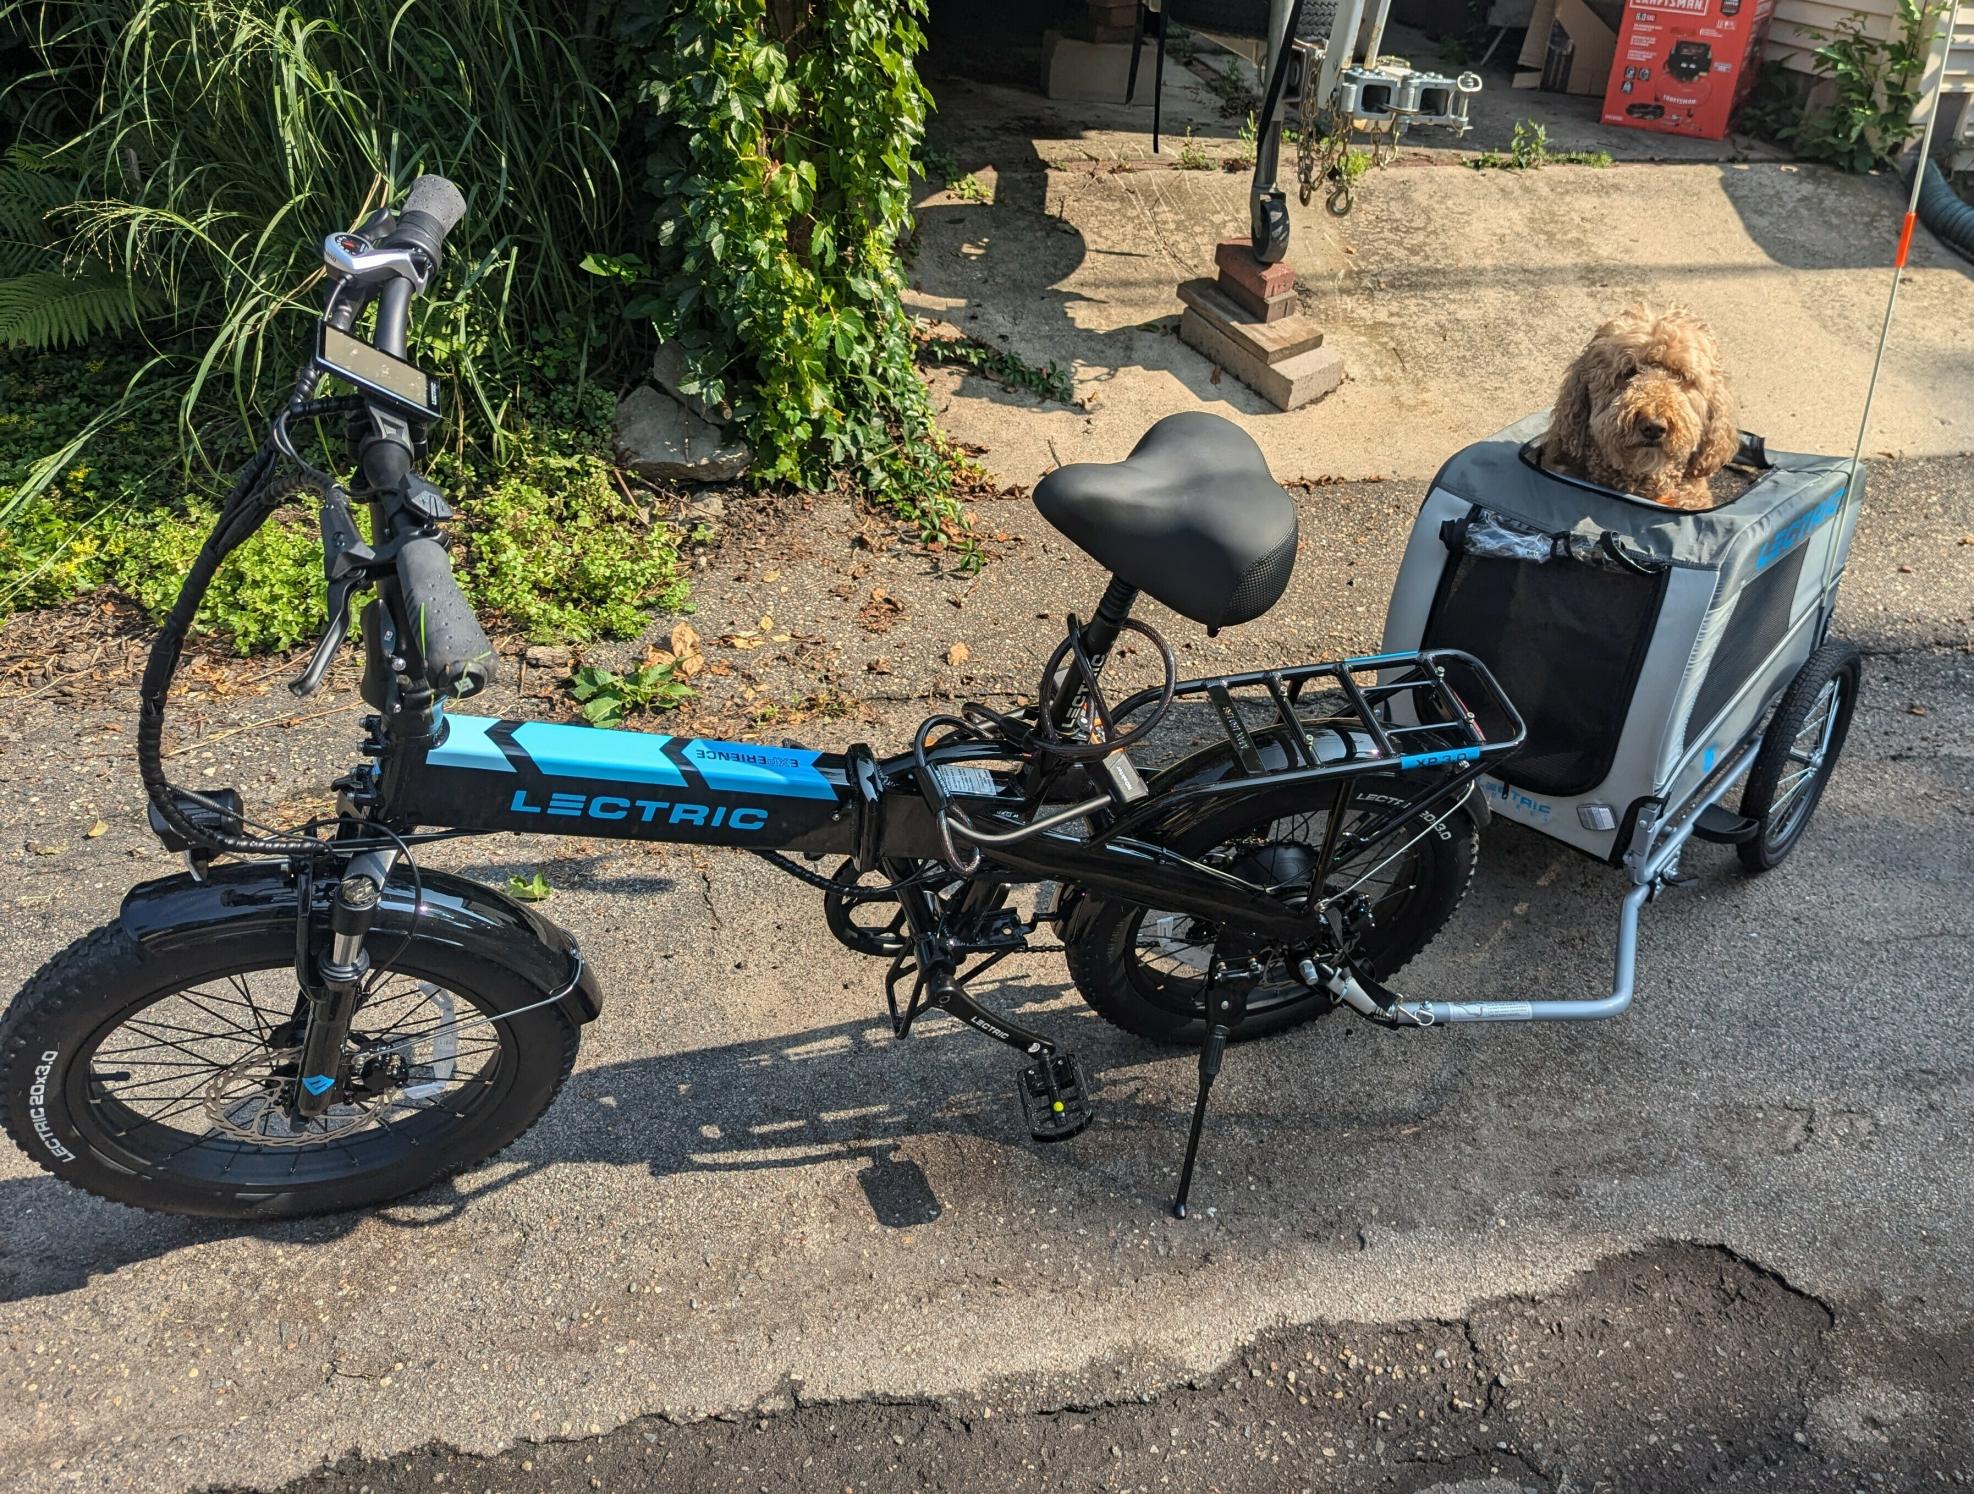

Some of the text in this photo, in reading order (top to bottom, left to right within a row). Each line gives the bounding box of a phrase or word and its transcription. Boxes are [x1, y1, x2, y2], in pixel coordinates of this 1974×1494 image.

[1061, 654, 1106, 728] LECTIC
[510, 790, 769, 830] LECTRIC
[970, 1016, 1010, 1039] LECTRIC
[29, 1051, 76, 1163] LECTRIC 20x3.0
